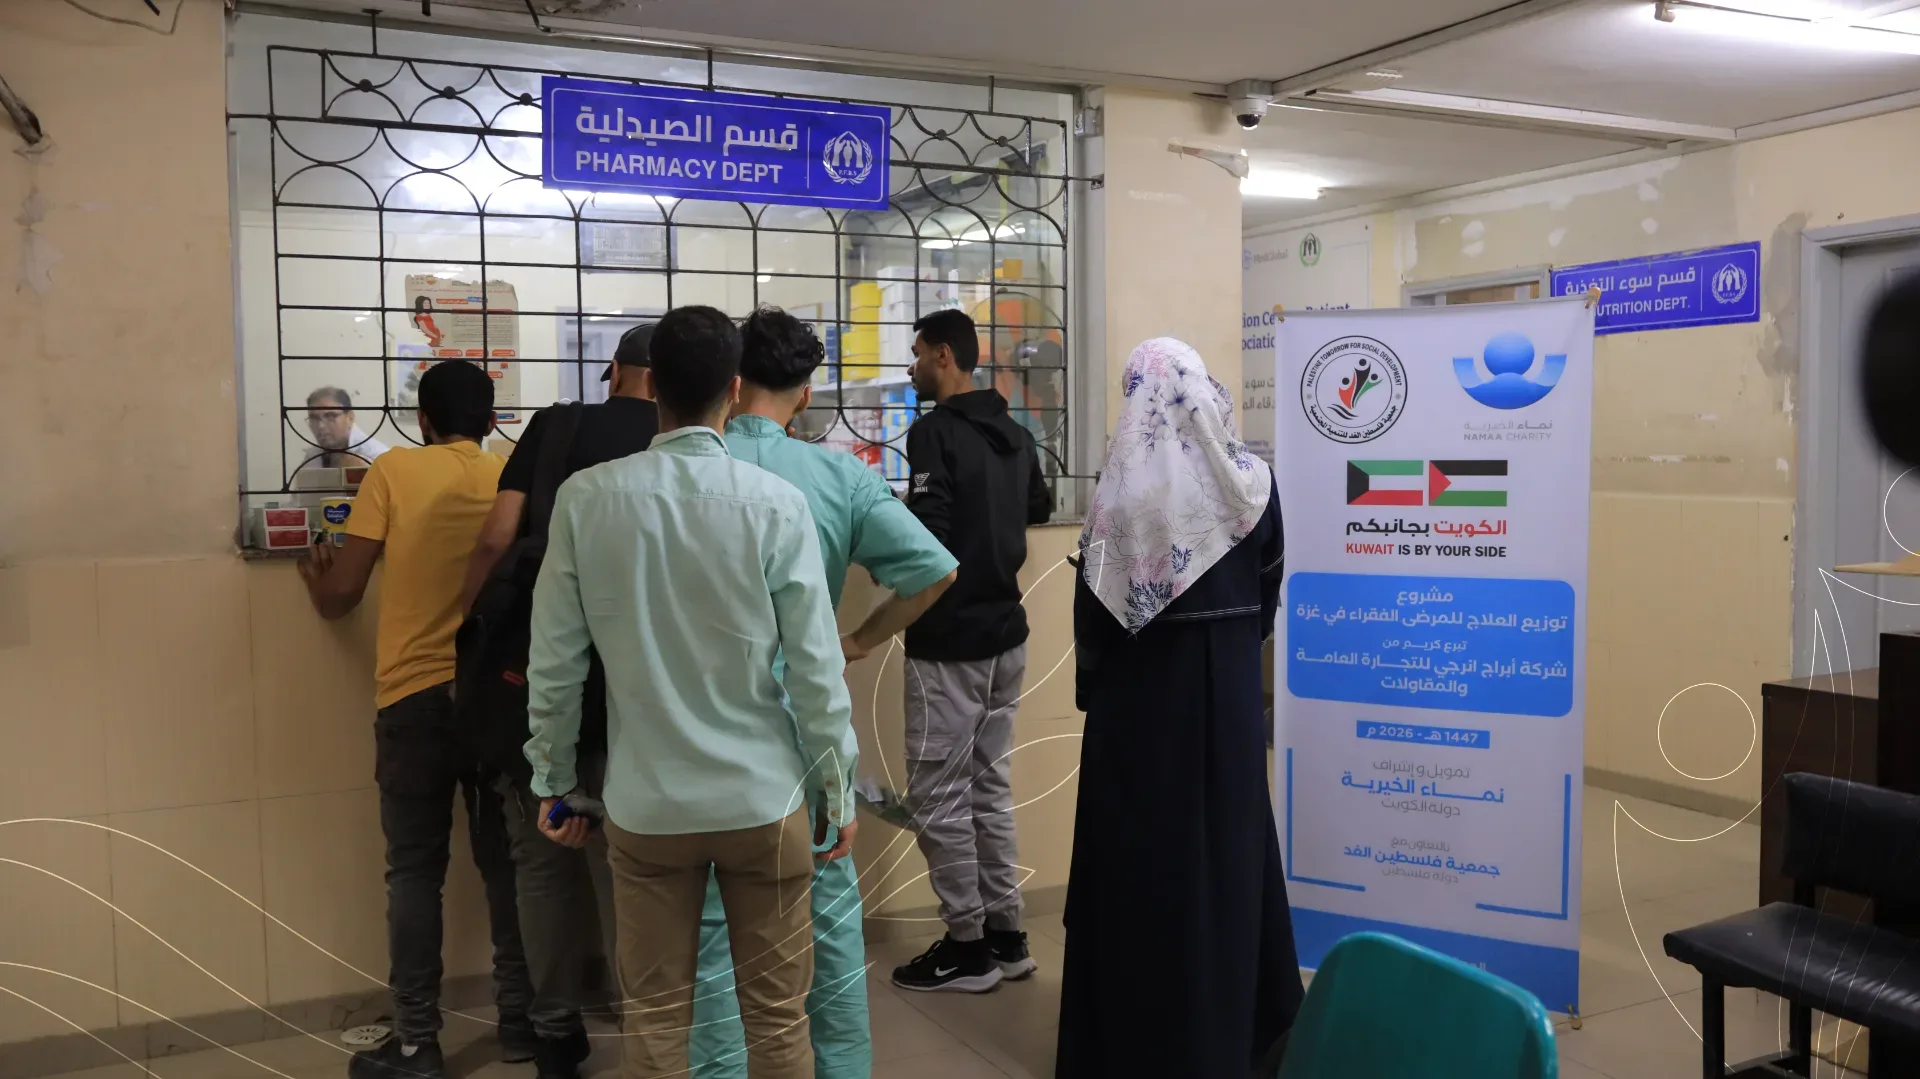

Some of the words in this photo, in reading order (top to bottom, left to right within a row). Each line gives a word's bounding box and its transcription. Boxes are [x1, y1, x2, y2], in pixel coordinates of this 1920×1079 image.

[576, 106, 712, 146] الصيدلية
[723, 124, 798, 156] قسم
[576, 151, 716, 180] PHARMACY
[722, 161, 783, 184] DEPT
[1619, 276, 1652, 293] سوء
[1657, 266, 1696, 292] قسم
[1595, 300, 1651, 318] UTRITION
[1655, 296, 1690, 312] DEPT.
[1307, 360, 1323, 387] PALESTINE
[1320, 343, 1350, 361] TOMORROW
[1361, 343, 1381, 355] SOCIAL
[1380, 351, 1402, 386] DEVELOPMENT
[1362, 422, 1384, 439] فلسطين
[1517, 419, 1552, 430] نماء
[1463, 433, 1503, 441] NAMAA
[1506, 432, 1552, 441] CHARITY
[1346, 518, 1430, 538] بجانبكم
[1433, 520, 1507, 538] الكويت
[1346, 543, 1395, 555] KUWAIT
[1398, 544, 1411, 556] IS
[1414, 545, 1432, 556] BY
[1435, 545, 1471, 557] YOUR
[1475, 546, 1507, 558] SIDE
[1396, 585, 1454, 606] مشروع
[1296, 604, 1321, 620] غزة
[1323, 606, 1346, 626] في
[1350, 608, 1399, 624] الفقراء
[1402, 610, 1463, 627] للمرضى
[1466, 613, 1517, 631] العلاج
[1520, 615, 1568, 632] توزيع
[1382, 638, 1400, 650] من
[1443, 640, 1468, 652] تبرع
[1434, 658, 1477, 678] انرجي
[1480, 658, 1516, 678] أبراج
[1519, 661, 1567, 679] شركة
[1381, 676, 1468, 697] والمقاولات
[1366, 727, 1377, 738] م
[1379, 725, 1414, 738] 2026
[1444, 731, 1479, 744] 1447
[1427, 763, 1471, 780] تمويل
[1381, 799, 1427, 814] الكويت
[1344, 844, 1372, 858] الغد
[1375, 850, 1442, 868] فلسطين
[1446, 856, 1501, 878] جمعية
